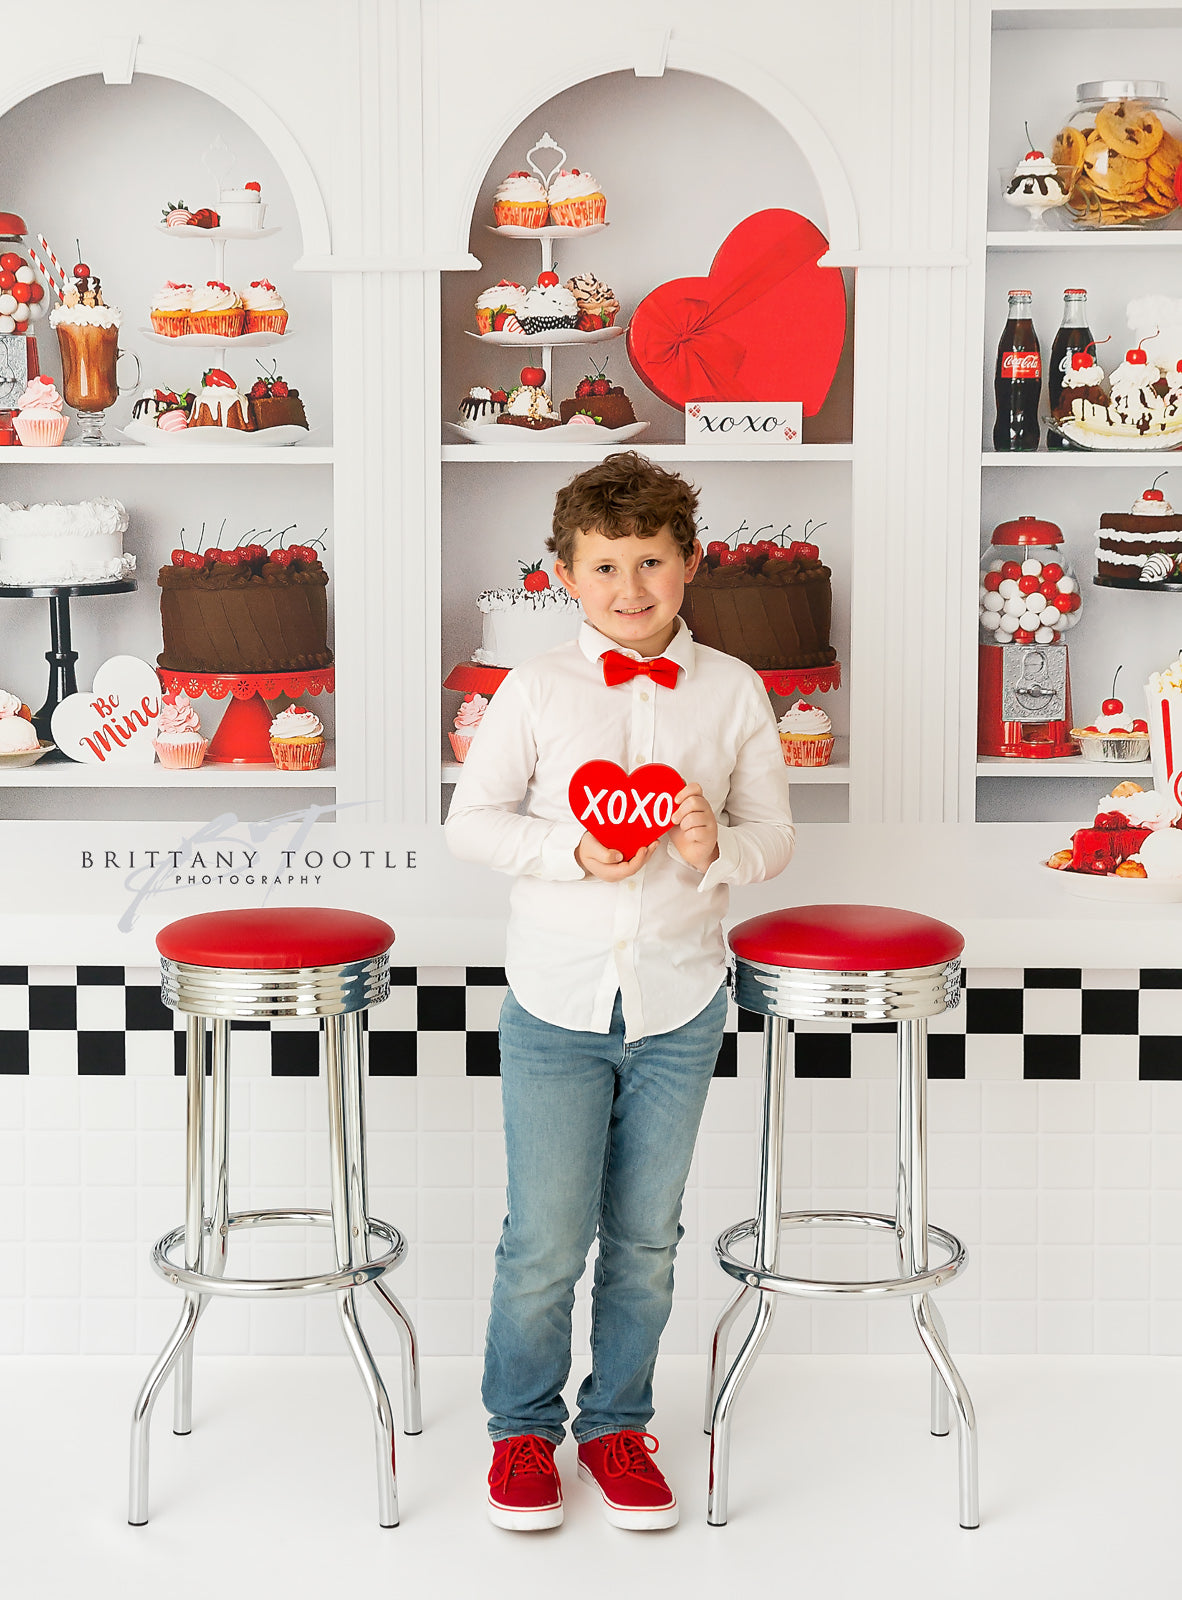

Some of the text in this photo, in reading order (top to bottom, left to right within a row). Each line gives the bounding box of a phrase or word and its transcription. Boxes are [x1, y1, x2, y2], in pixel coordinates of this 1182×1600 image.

[698, 415, 787, 433] xoxo
[89, 694, 120, 719] Be
[78, 695, 160, 762] Mine
[580, 785, 674, 829] XOXO
